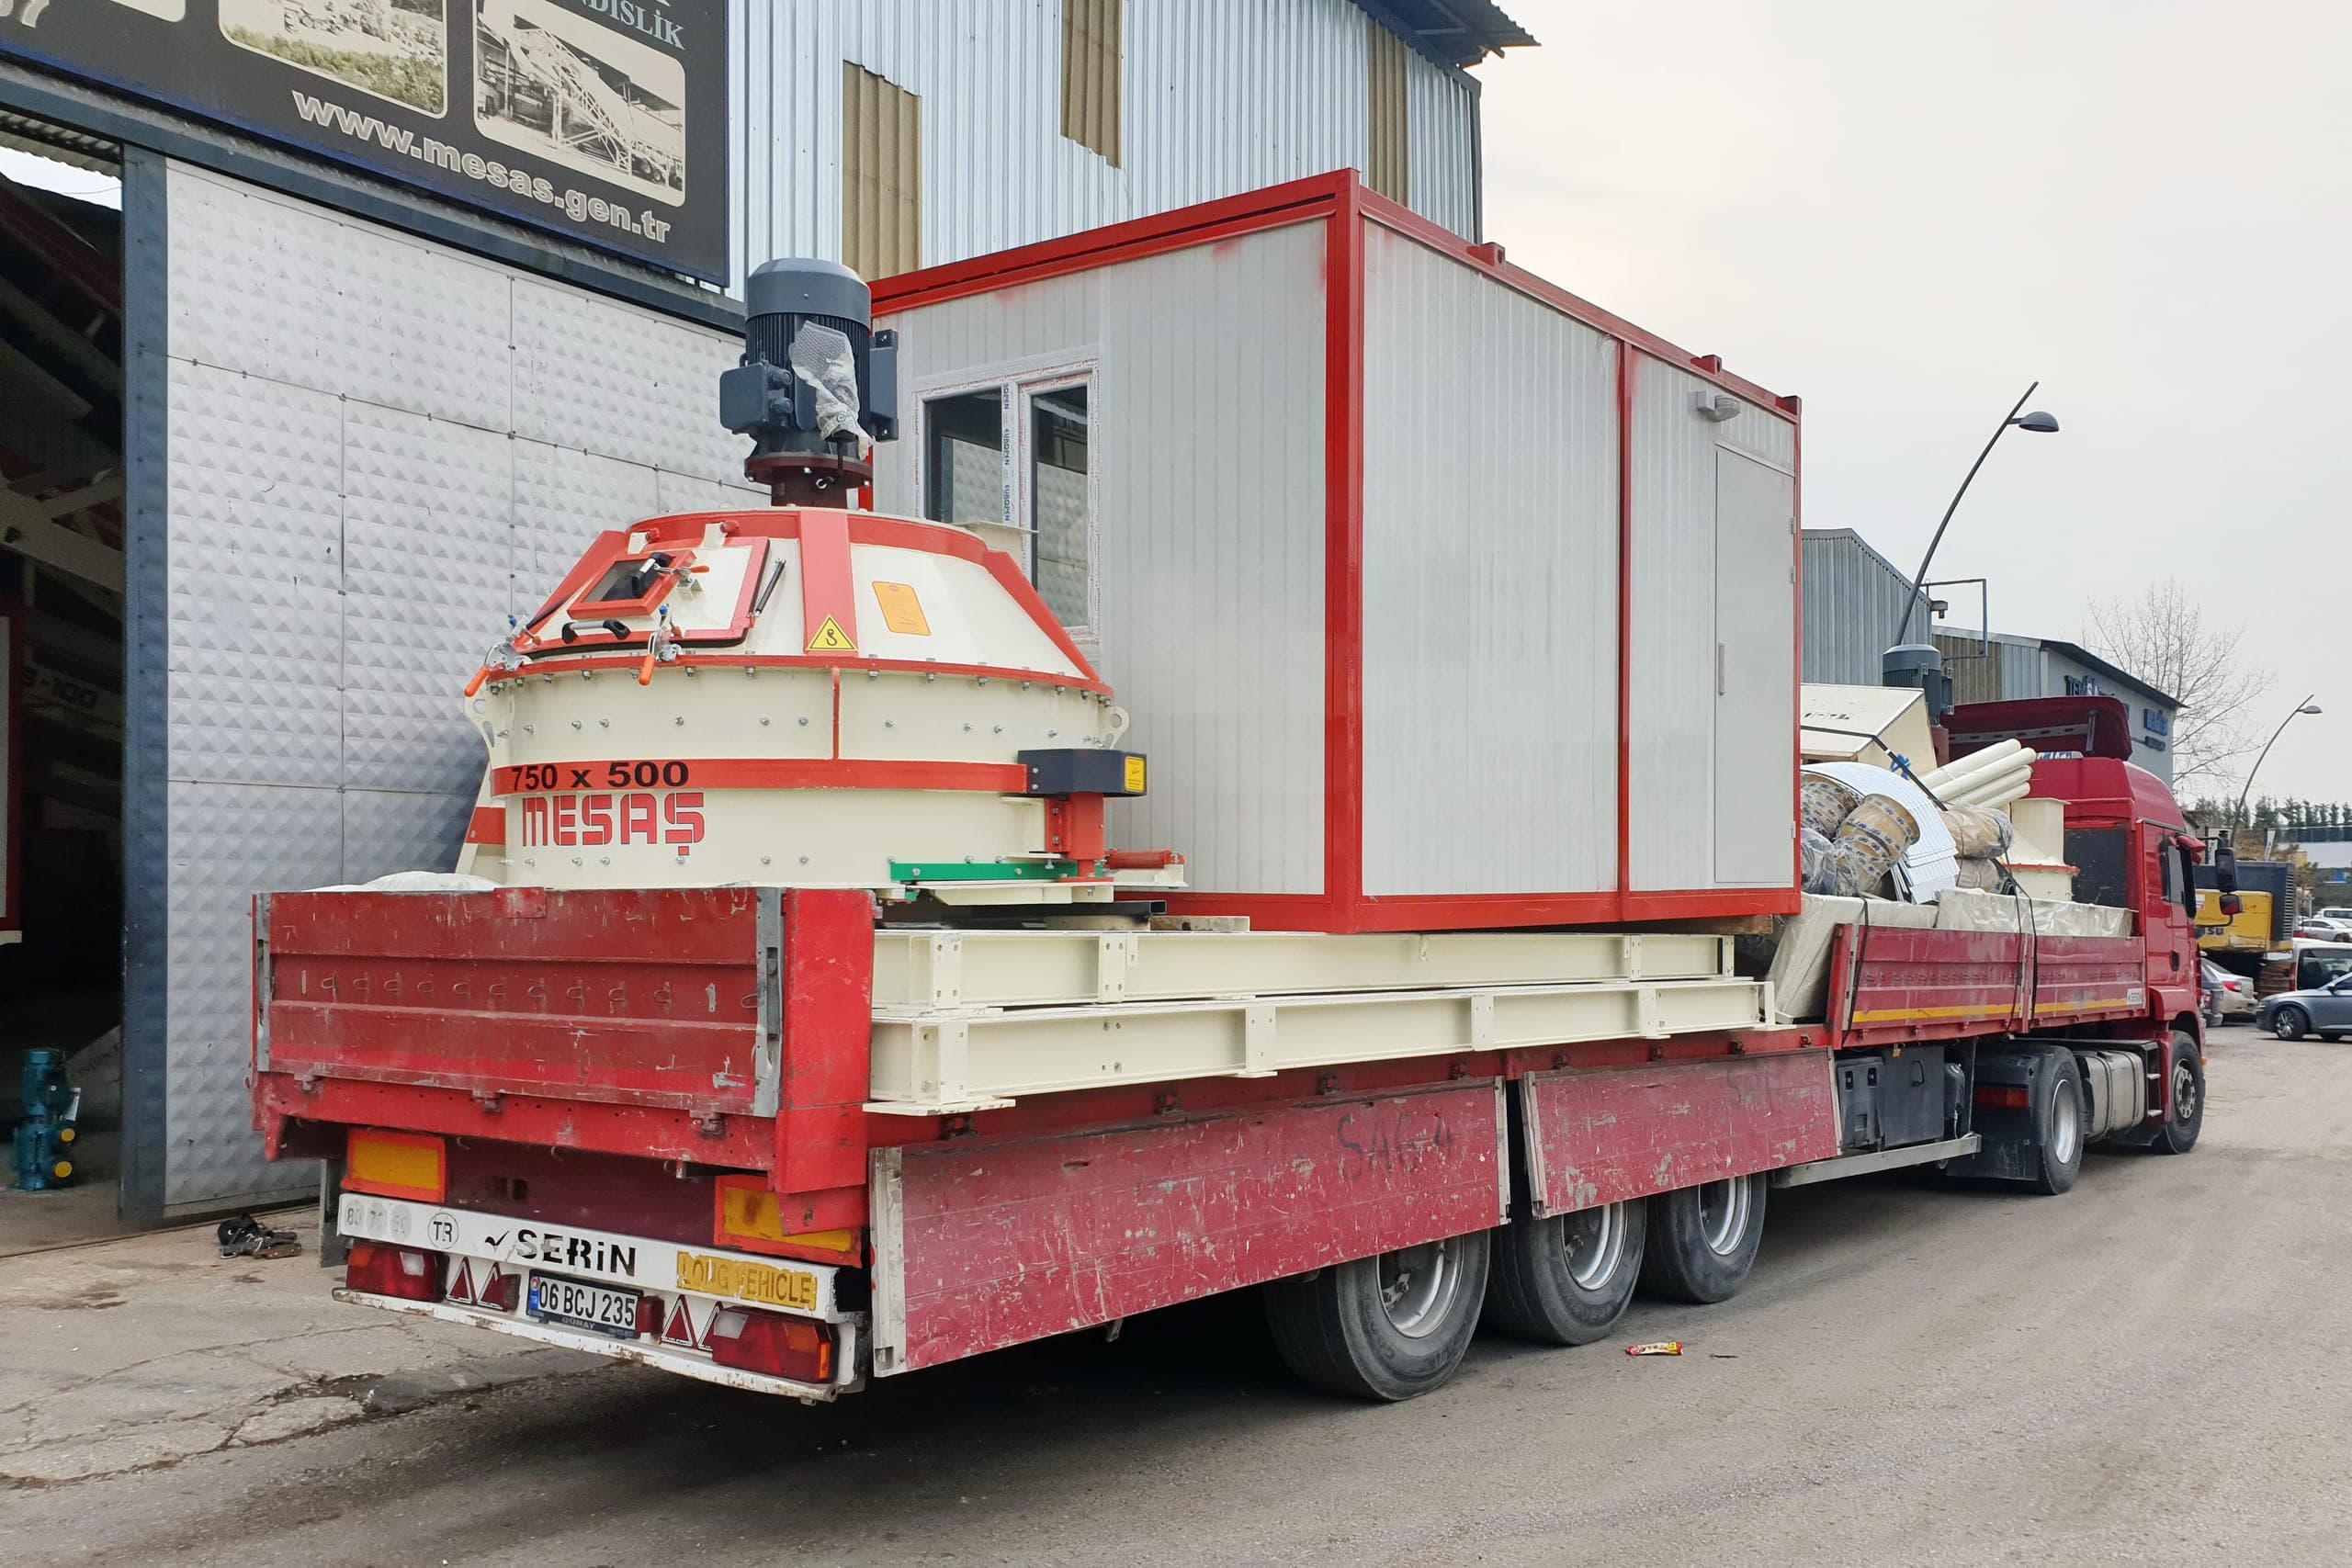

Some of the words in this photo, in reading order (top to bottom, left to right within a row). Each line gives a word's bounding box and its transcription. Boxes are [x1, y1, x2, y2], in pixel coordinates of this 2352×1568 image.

[291, 90, 671, 243] www.mesas.gen.tr
[512, 764, 558, 792] 750
[570, 769, 592, 788] x
[607, 761, 689, 788] 500
[522, 792, 705, 856] MESAŞ
[433, 1221, 452, 1243] TR
[539, 1280, 559, 1310] 06
[563, 1286, 596, 1318] BCJ
[601, 1293, 635, 1326] 235
